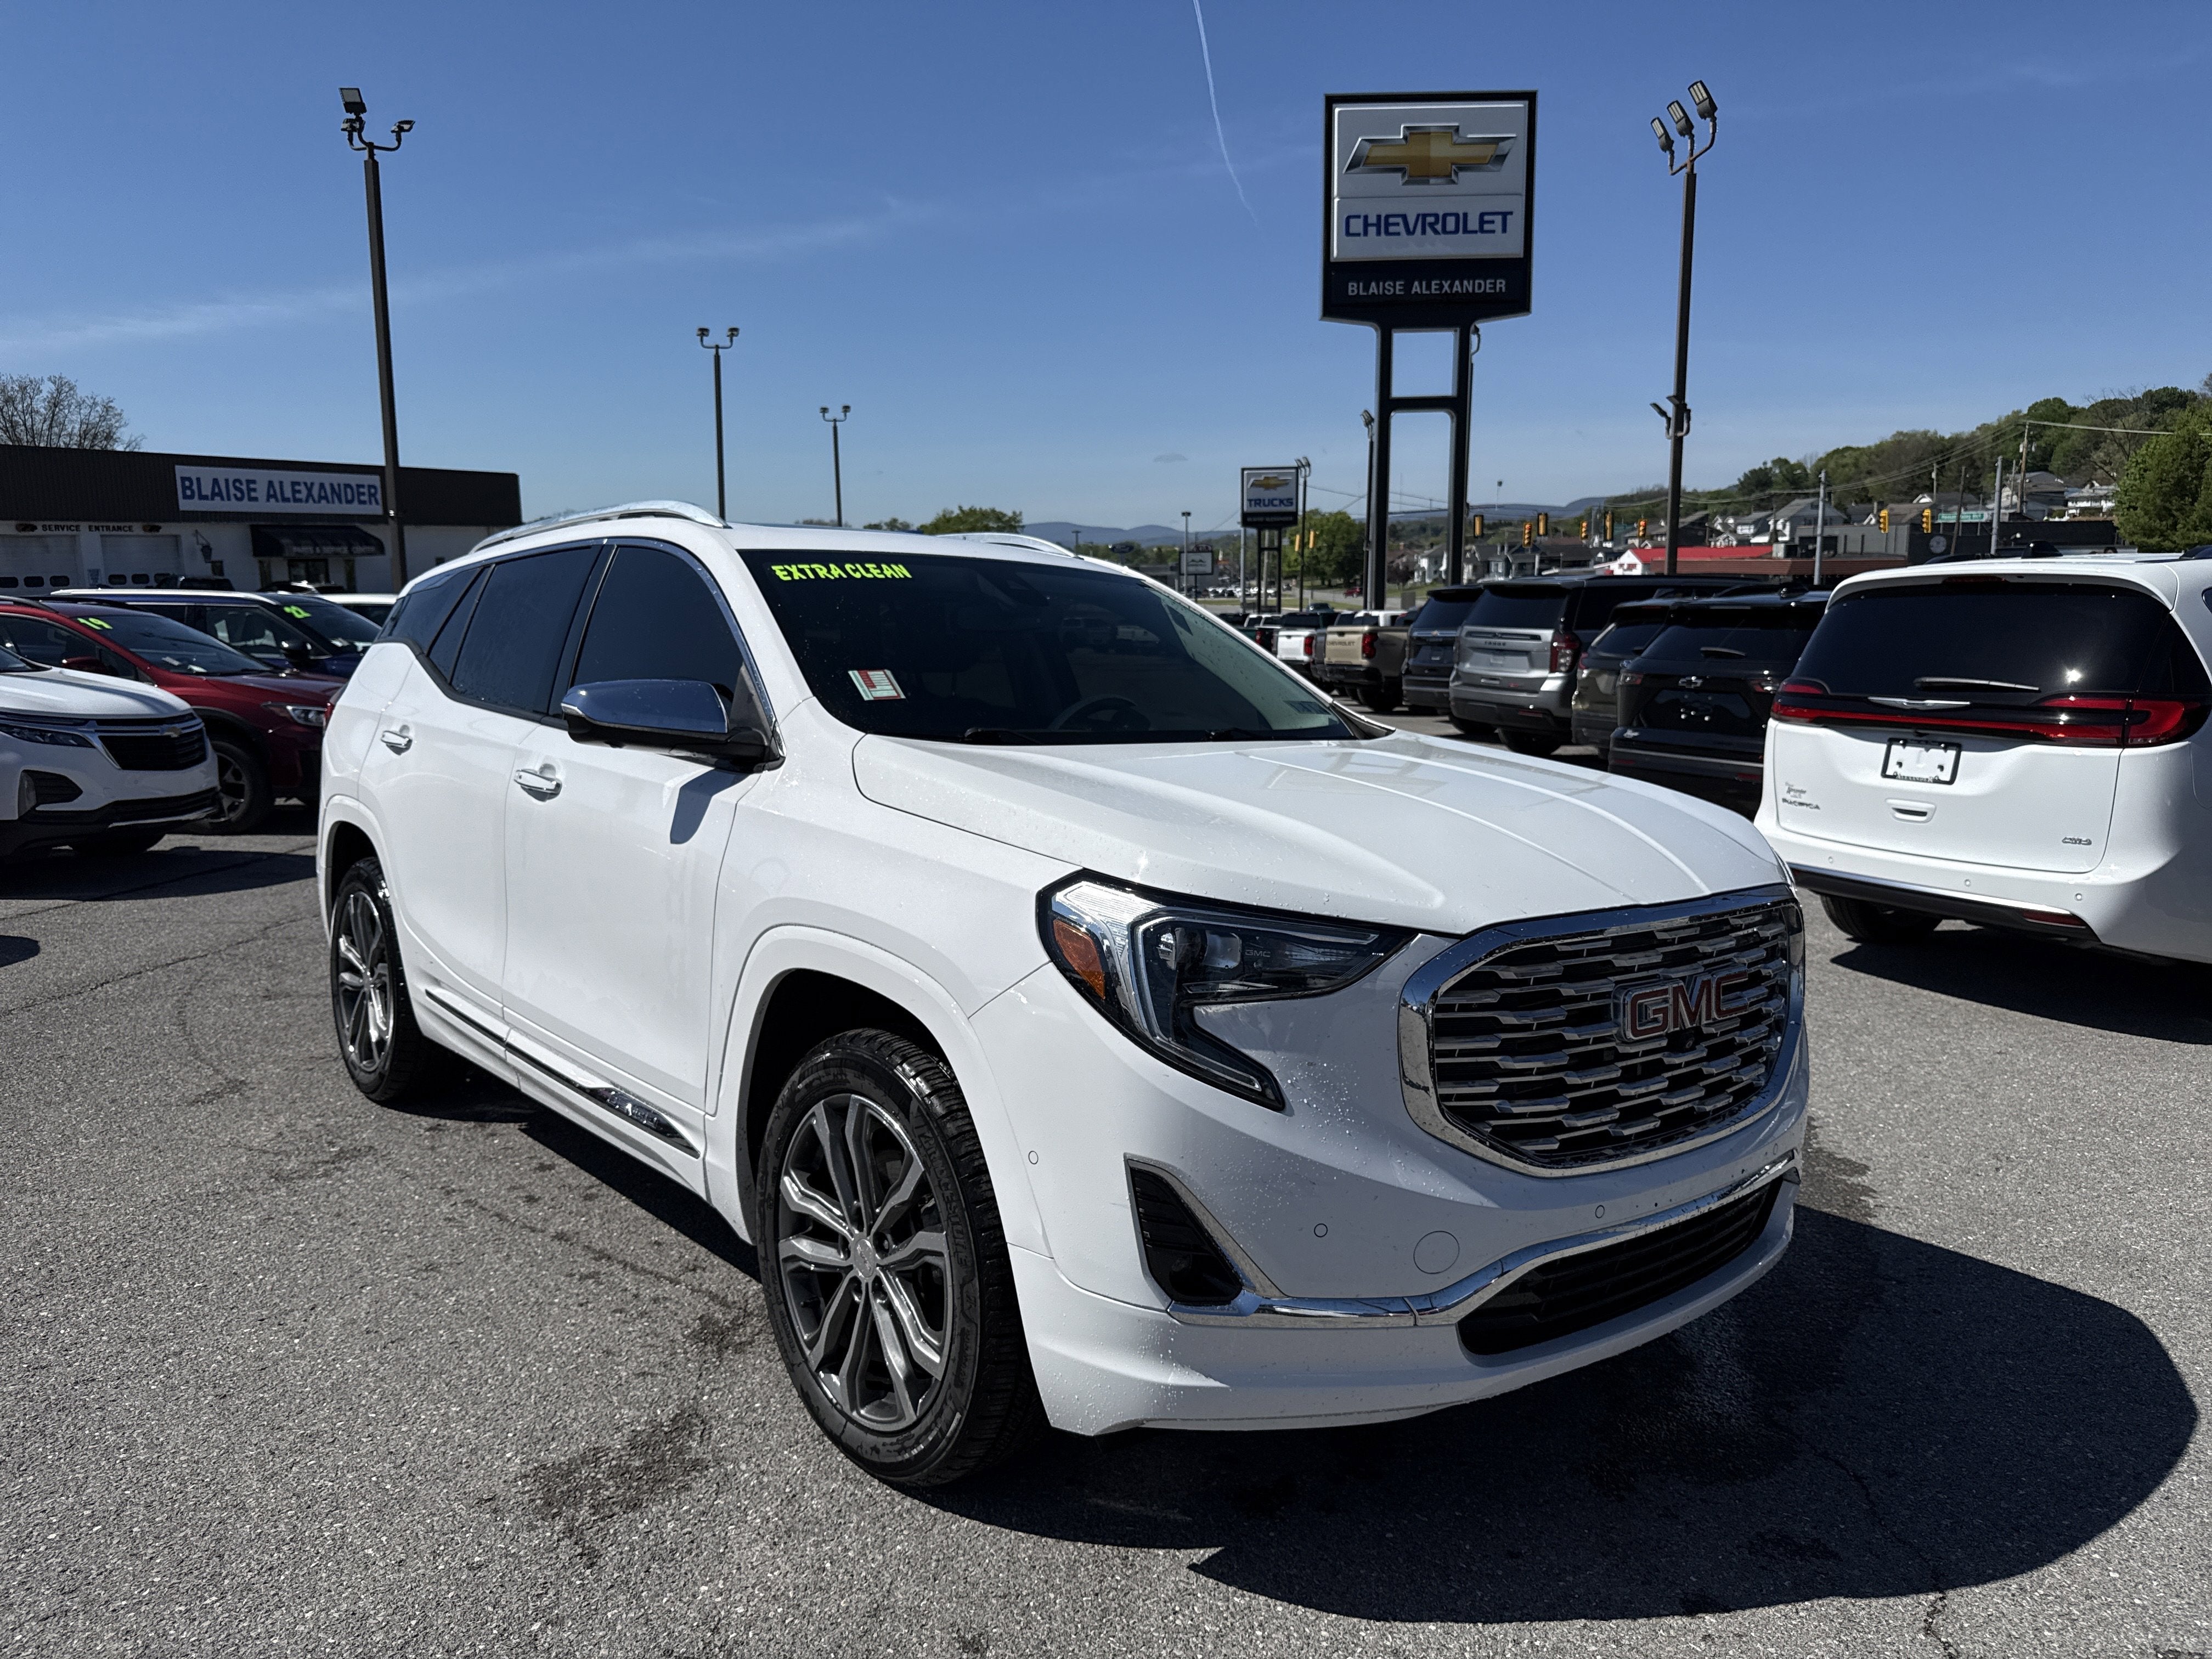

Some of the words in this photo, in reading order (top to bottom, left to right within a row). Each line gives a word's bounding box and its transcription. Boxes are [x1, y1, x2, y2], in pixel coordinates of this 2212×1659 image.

[1345, 211, 1513, 237] CHEVROLET
[1348, 280, 1404, 296] BLAISE
[1411, 279, 1506, 295] ALEXANDER
[180, 476, 259, 503] BLAISE
[266, 479, 380, 506] ALEXANDER
[1247, 498, 1294, 507] TRUCKS
[42, 524, 81, 532] SERVICE
[771, 563, 848, 580] EXTRA
[844, 563, 912, 579] CLEAN
[1245, 949, 1271, 957] GMC
[1625, 969, 1748, 1040] GMC
